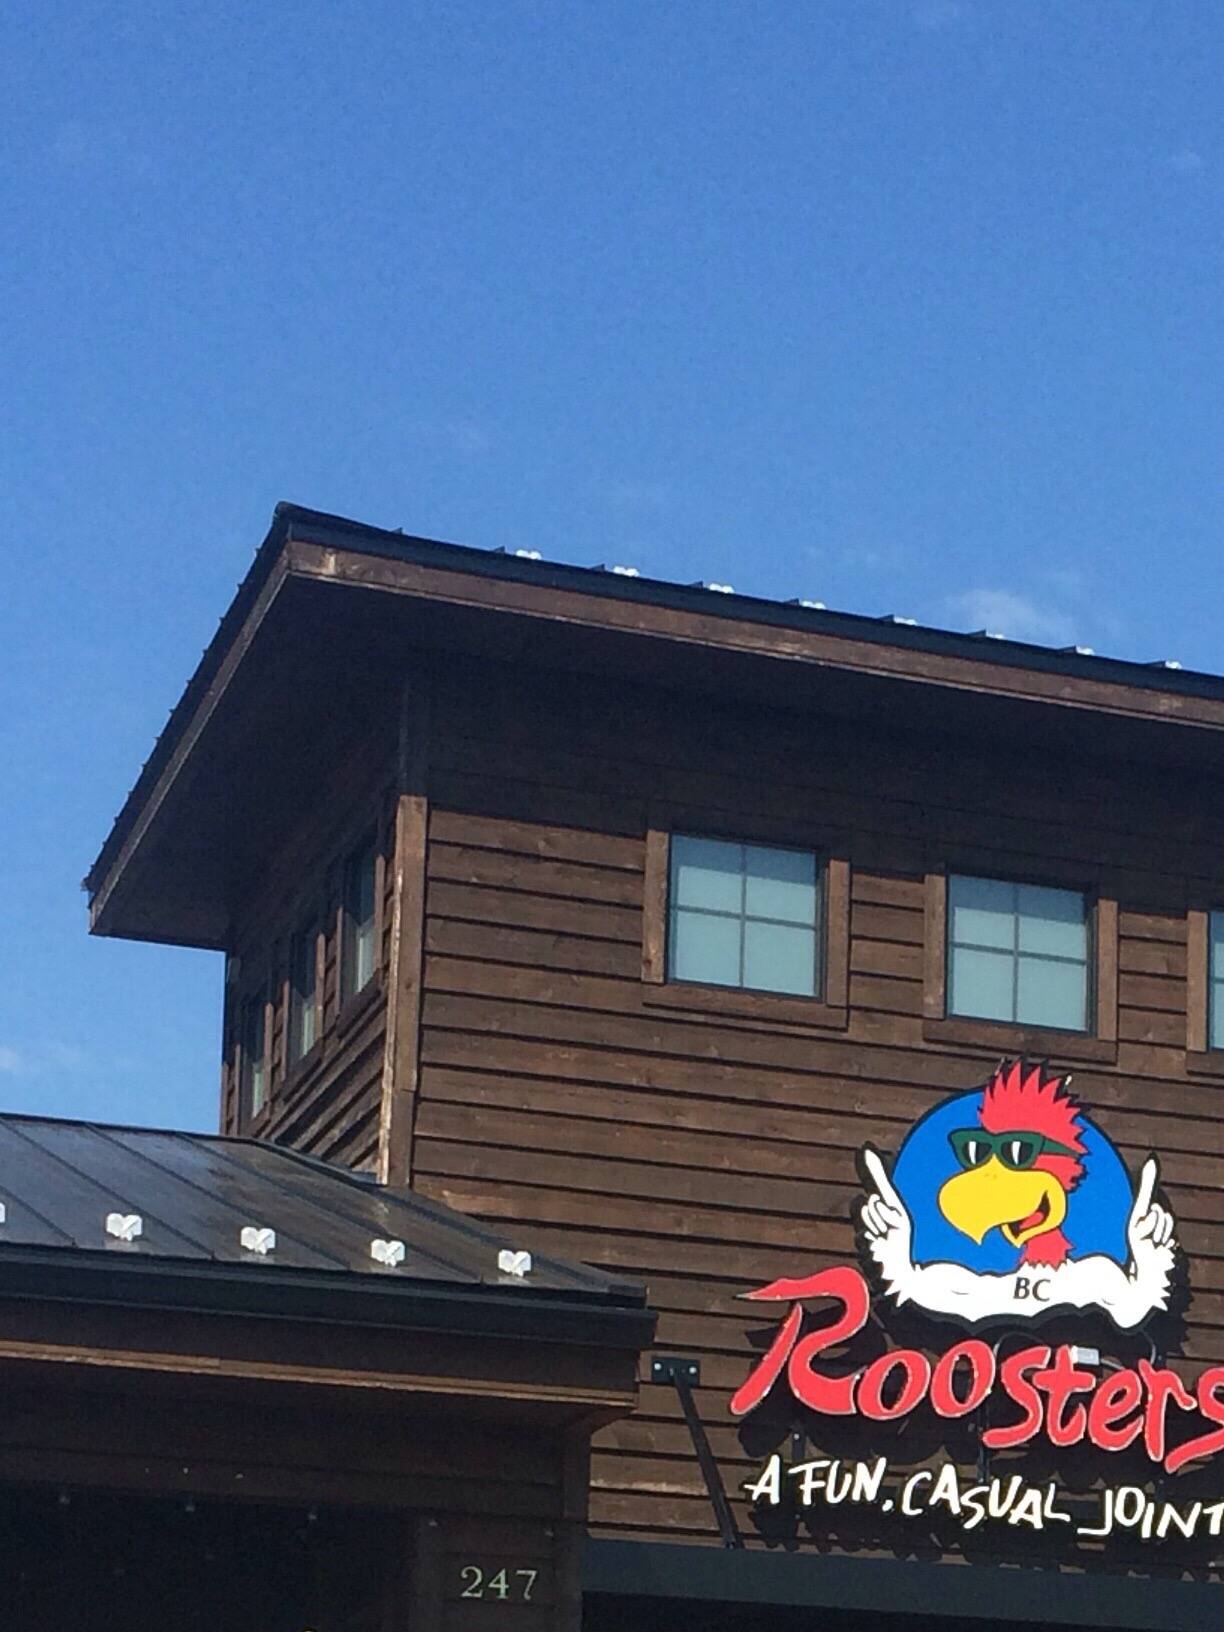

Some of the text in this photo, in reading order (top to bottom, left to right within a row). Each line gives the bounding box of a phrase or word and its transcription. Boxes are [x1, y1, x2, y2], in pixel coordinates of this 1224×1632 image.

[1013, 1276, 1051, 1302] BC
[745, 1455, 783, 1505] A
[789, 1457, 893, 1513] FUN,
[901, 1461, 1070, 1531] CASUAL
[461, 1566, 538, 1600] 247
